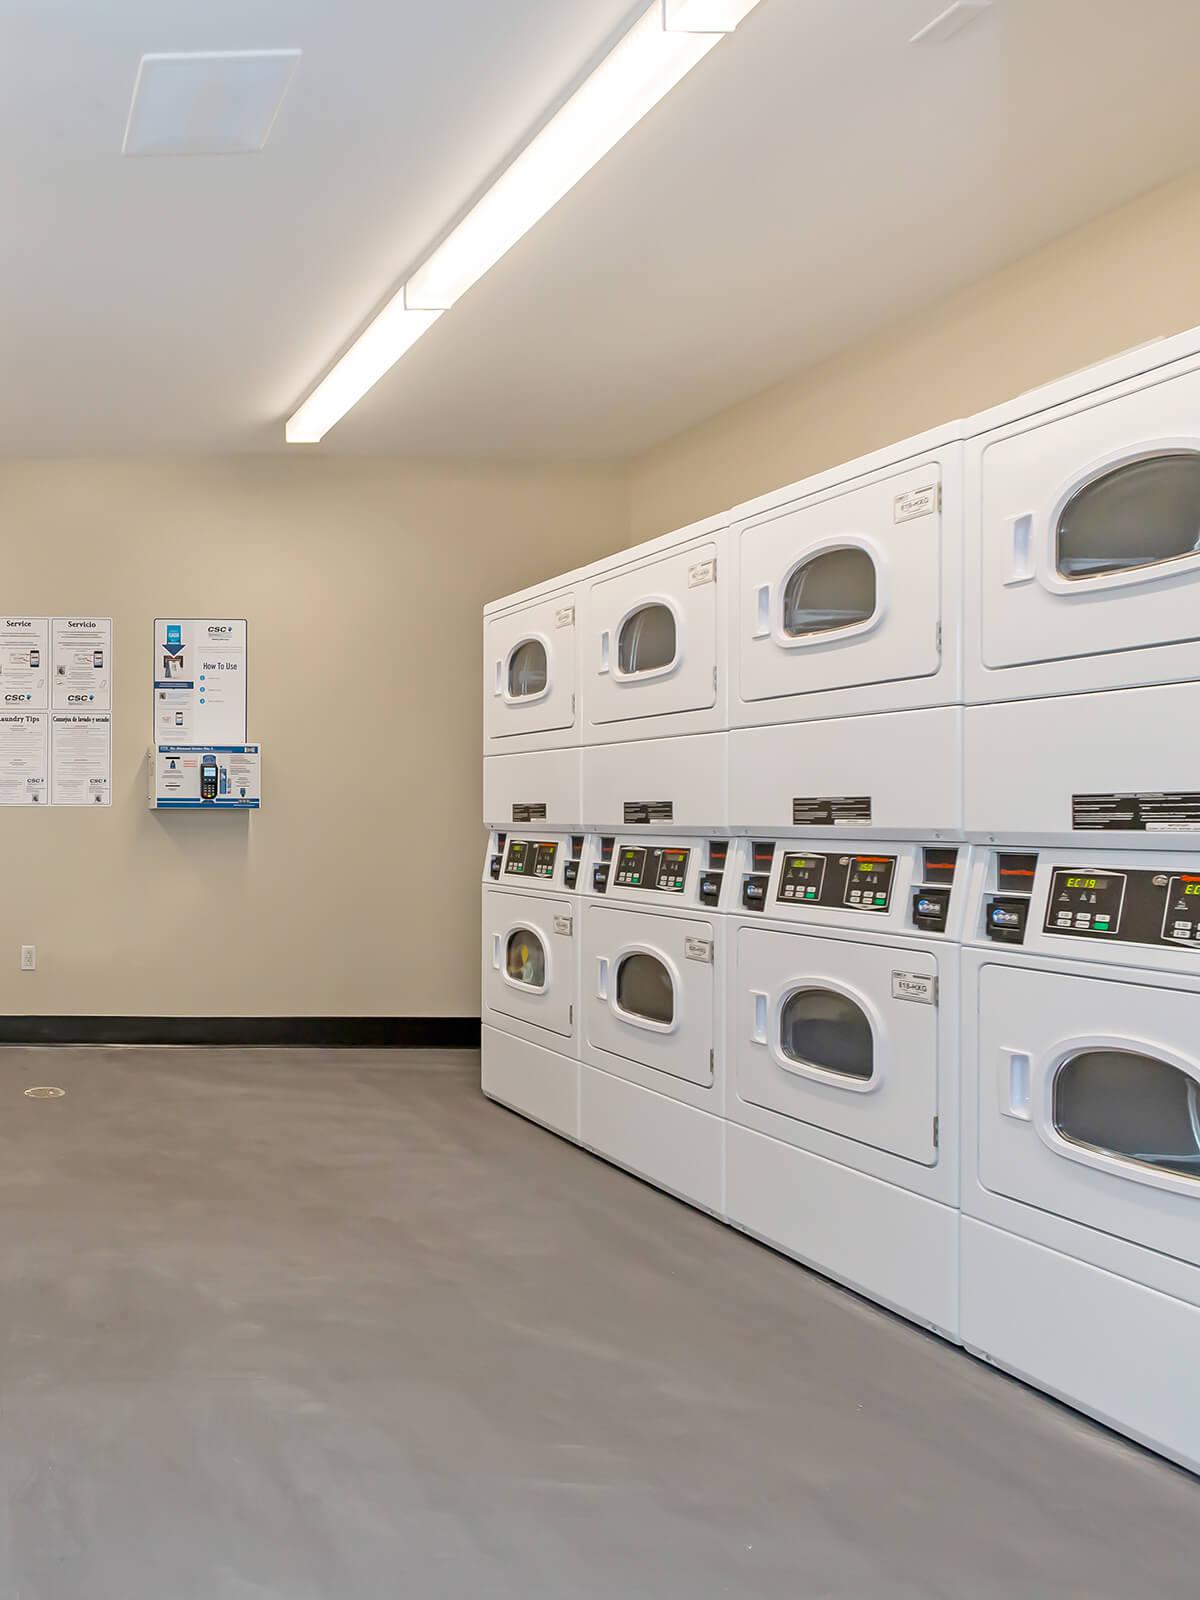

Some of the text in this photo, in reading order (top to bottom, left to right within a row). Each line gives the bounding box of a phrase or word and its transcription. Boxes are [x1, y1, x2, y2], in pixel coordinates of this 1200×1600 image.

[203, 662, 238, 670] How To Use
[26, 715, 40, 723] Tips
